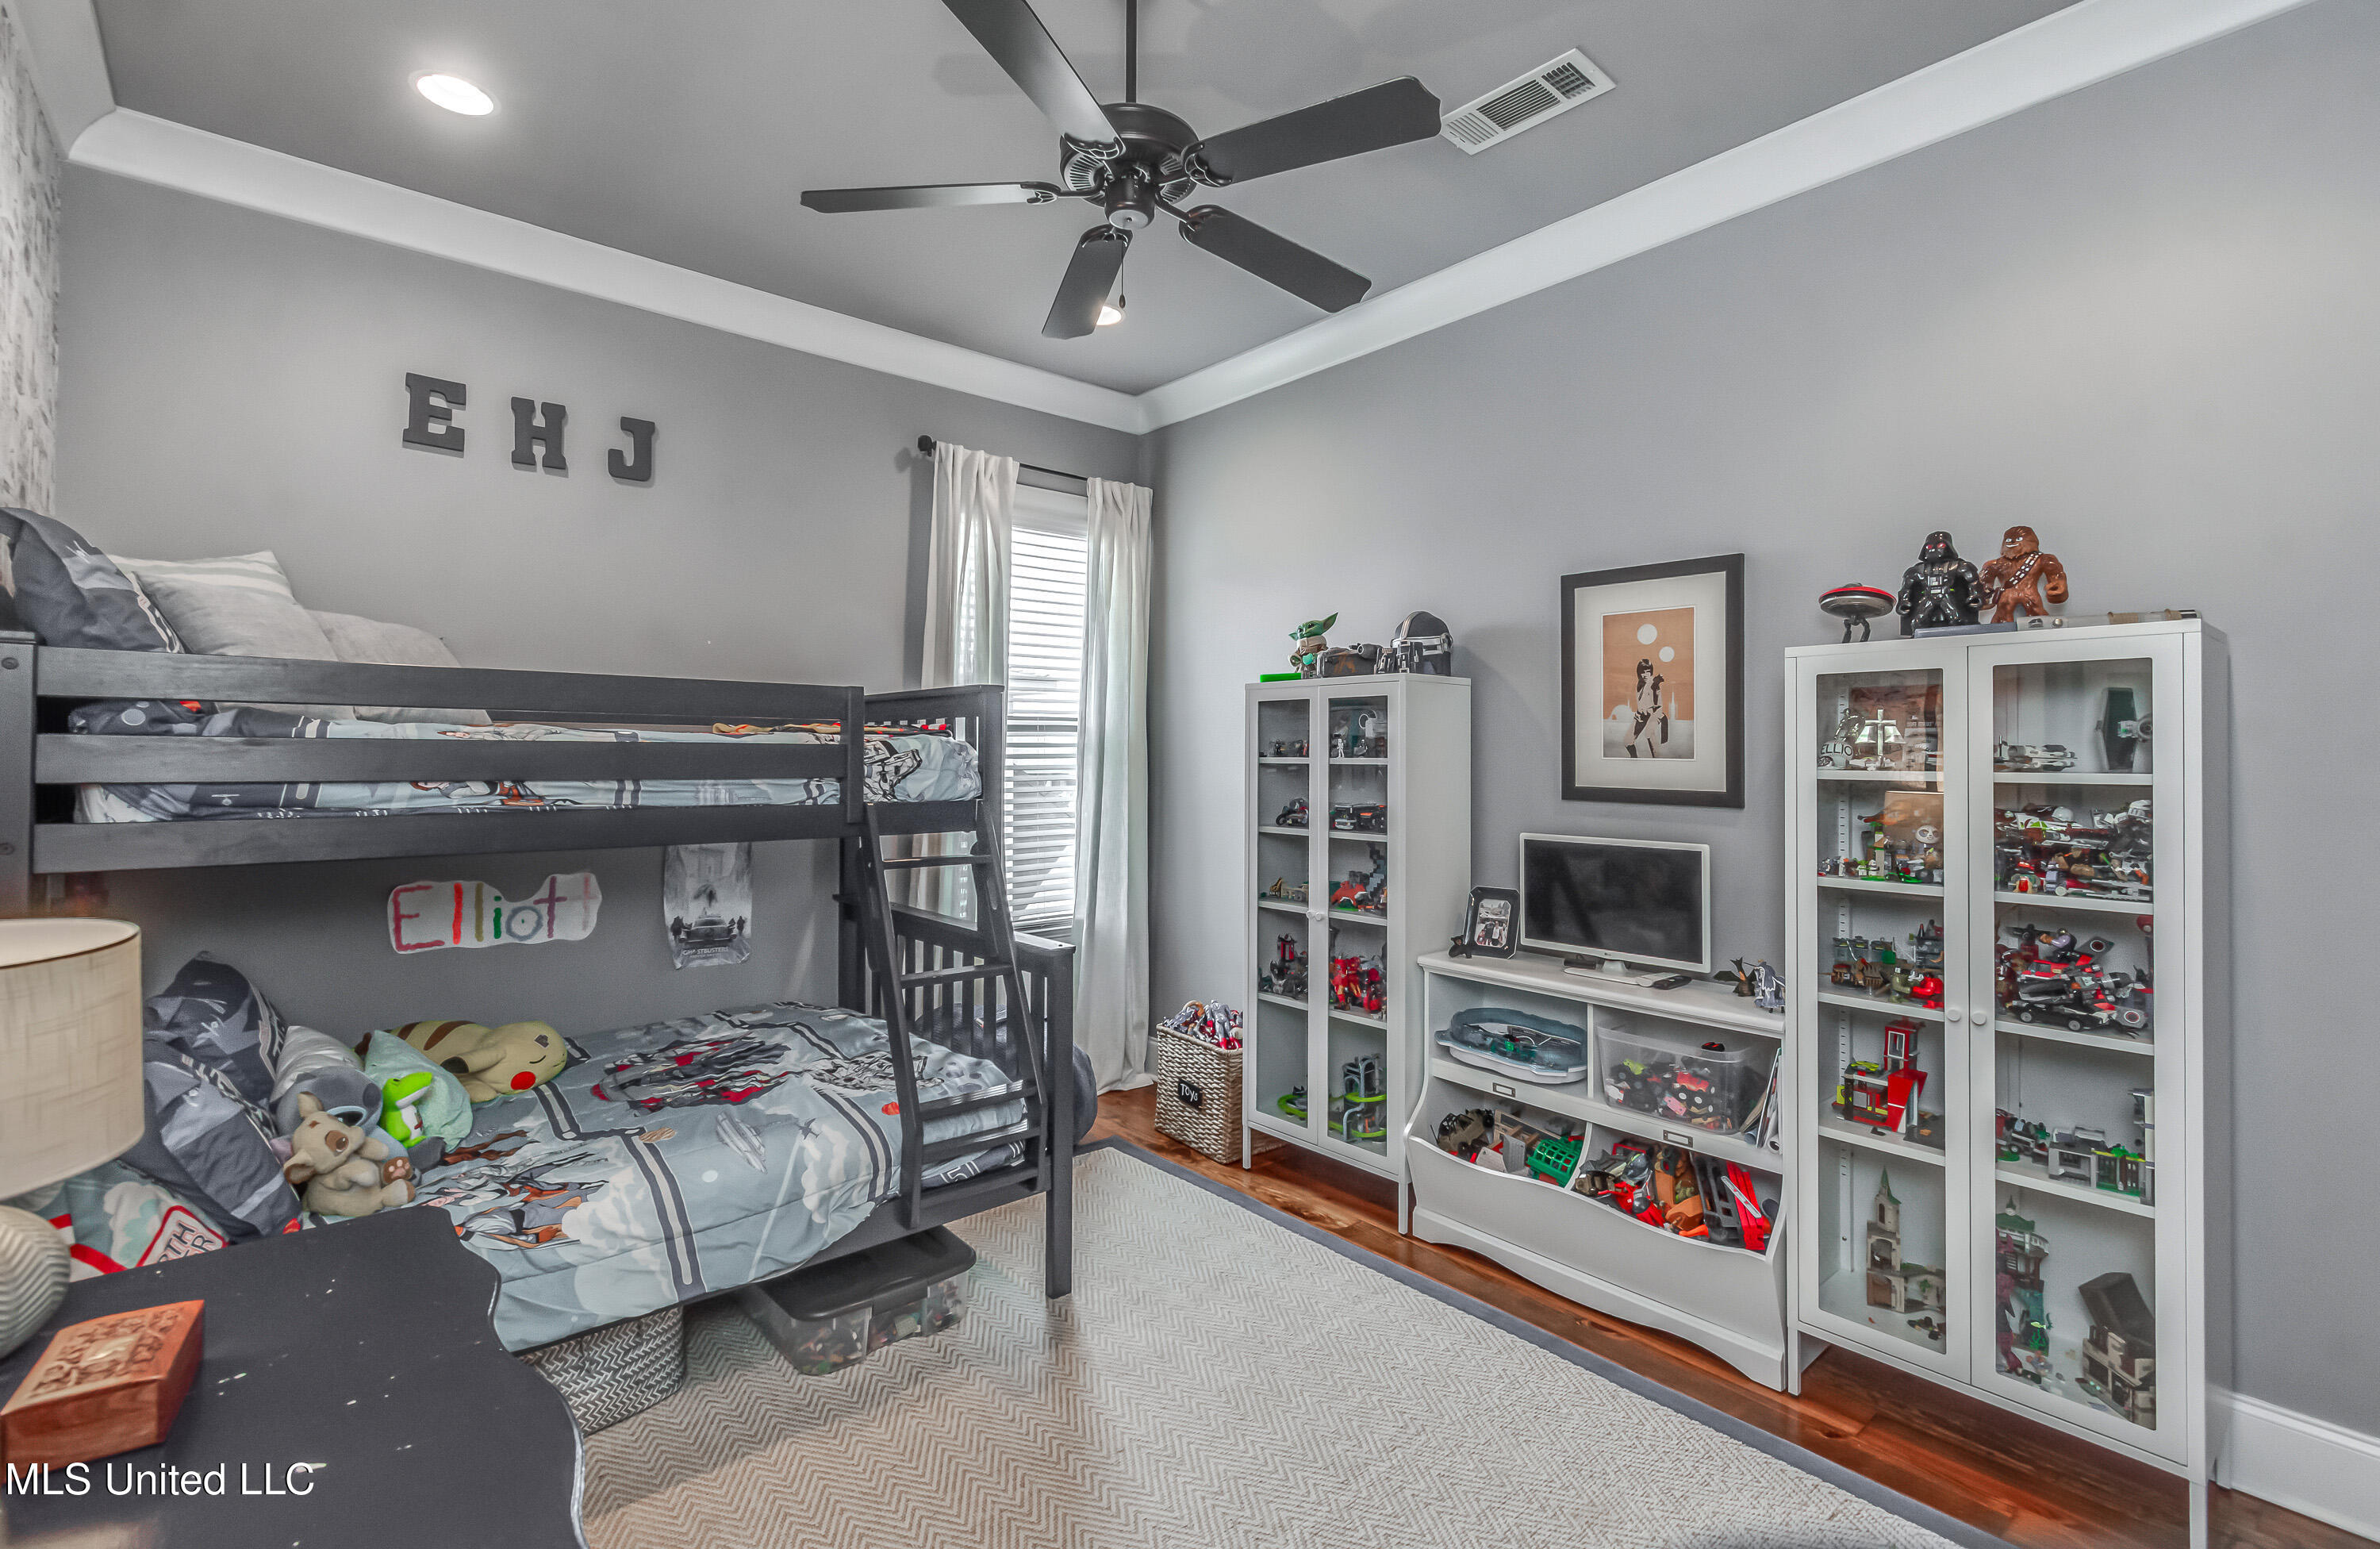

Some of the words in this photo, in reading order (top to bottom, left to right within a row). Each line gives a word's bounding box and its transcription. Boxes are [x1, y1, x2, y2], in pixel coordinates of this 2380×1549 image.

[402, 372, 466, 452] E
[511, 396, 567, 470] H
[608, 416, 655, 482] J
[392, 874, 597, 951] Elliott
